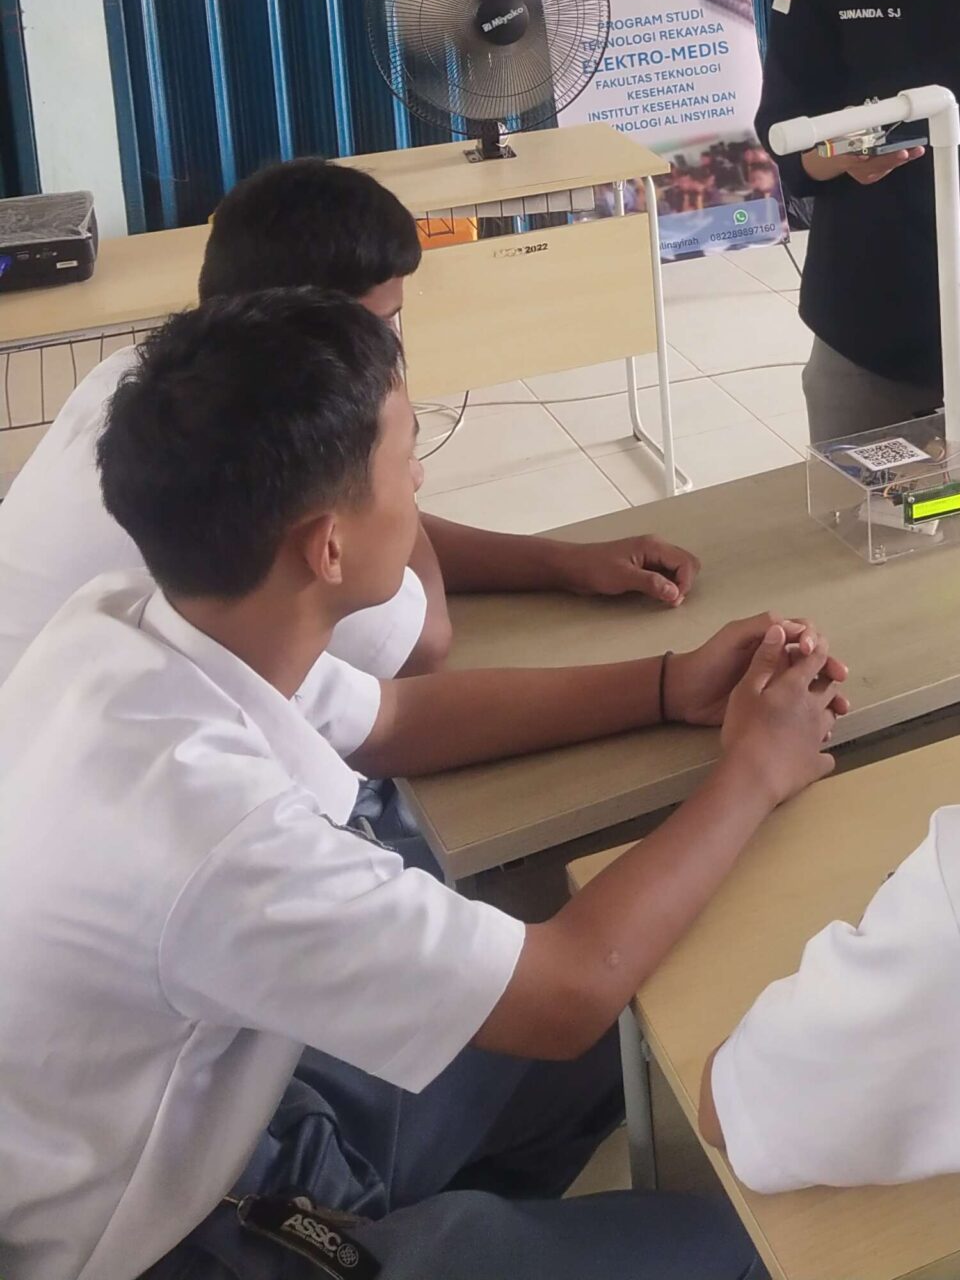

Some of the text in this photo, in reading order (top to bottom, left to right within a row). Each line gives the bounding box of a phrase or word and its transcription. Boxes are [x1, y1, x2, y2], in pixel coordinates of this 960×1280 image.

[491, 7, 524, 28] Miyako
[598, 8, 704, 32] PROGRAM STUDI
[838, 8, 902, 20] SUNANDA SJ
[659, 23, 725, 41] REKAYASA
[582, 40, 729, 75] ELEKTRO-MEDIS
[595, 63, 721, 90] FAKULTAS TEKNOLOGI
[627, 82, 695, 101] KESEHATAN
[588, 91, 737, 122] INSTITUT KESEHATAN DAN
[611, 106, 735, 133] NOLOGI AL INSYIRAH
[525, 243, 548, 254] 2022
